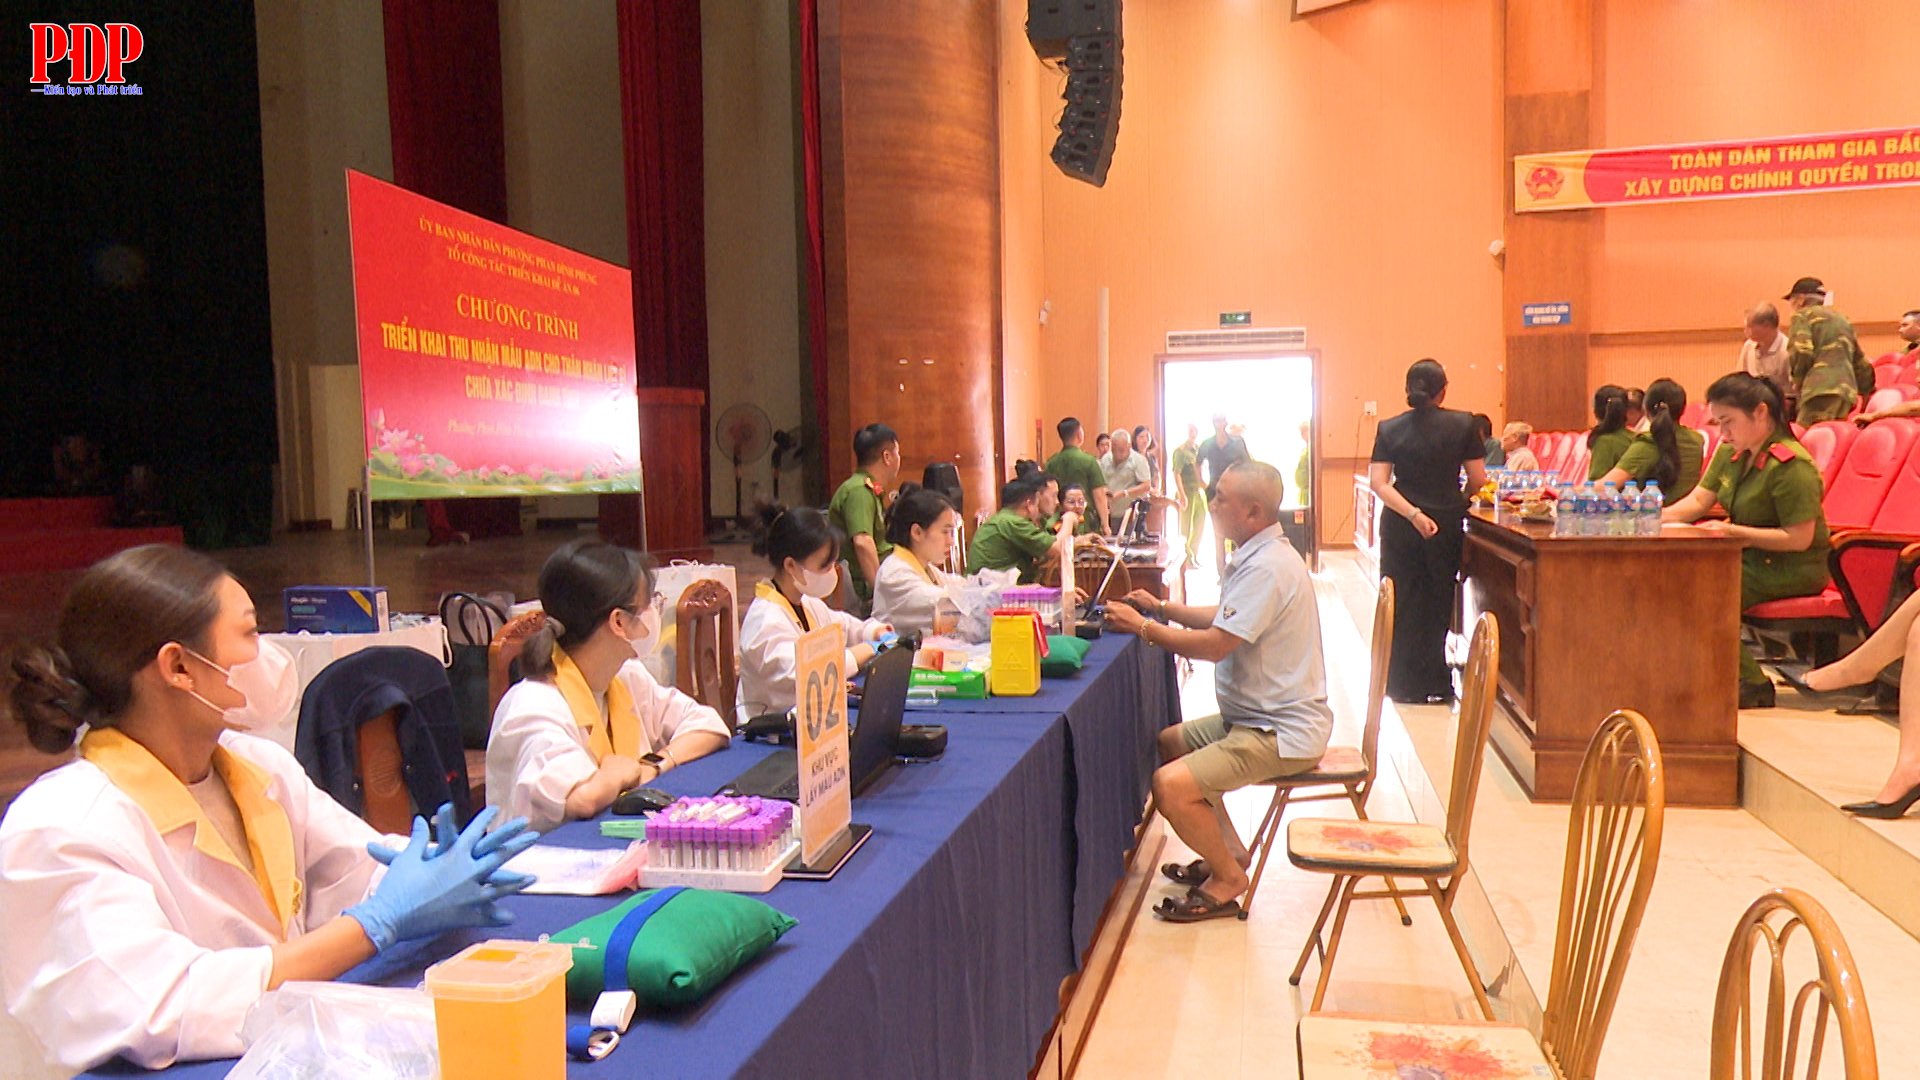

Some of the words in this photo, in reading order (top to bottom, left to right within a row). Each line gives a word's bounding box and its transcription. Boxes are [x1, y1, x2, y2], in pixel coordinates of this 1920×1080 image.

[1670, 149, 1722, 170] TOÀN
[1728, 145, 1771, 166] DÂN
[1778, 143, 1836, 162] THAM
[1842, 139, 1878, 158] GIA
[1625, 177, 1663, 197] XÂY
[1669, 175, 1724, 196] DỰNG
[1730, 169, 1793, 190] CHÍNH
[436, 223, 456, 240] BAN
[462, 250, 487, 270] CÔNG
[489, 257, 505, 273] TÁC
[456, 293, 531, 330] CHƯƠNG
[534, 310, 579, 340] TRÌNH
[381, 315, 417, 352] TRIỂN
[420, 329, 447, 358] KHAI
[449, 335, 470, 361] THU
[471, 337, 500, 370] NHẬN
[806, 662, 839, 741] 02
[811, 757, 824, 777] KHU
